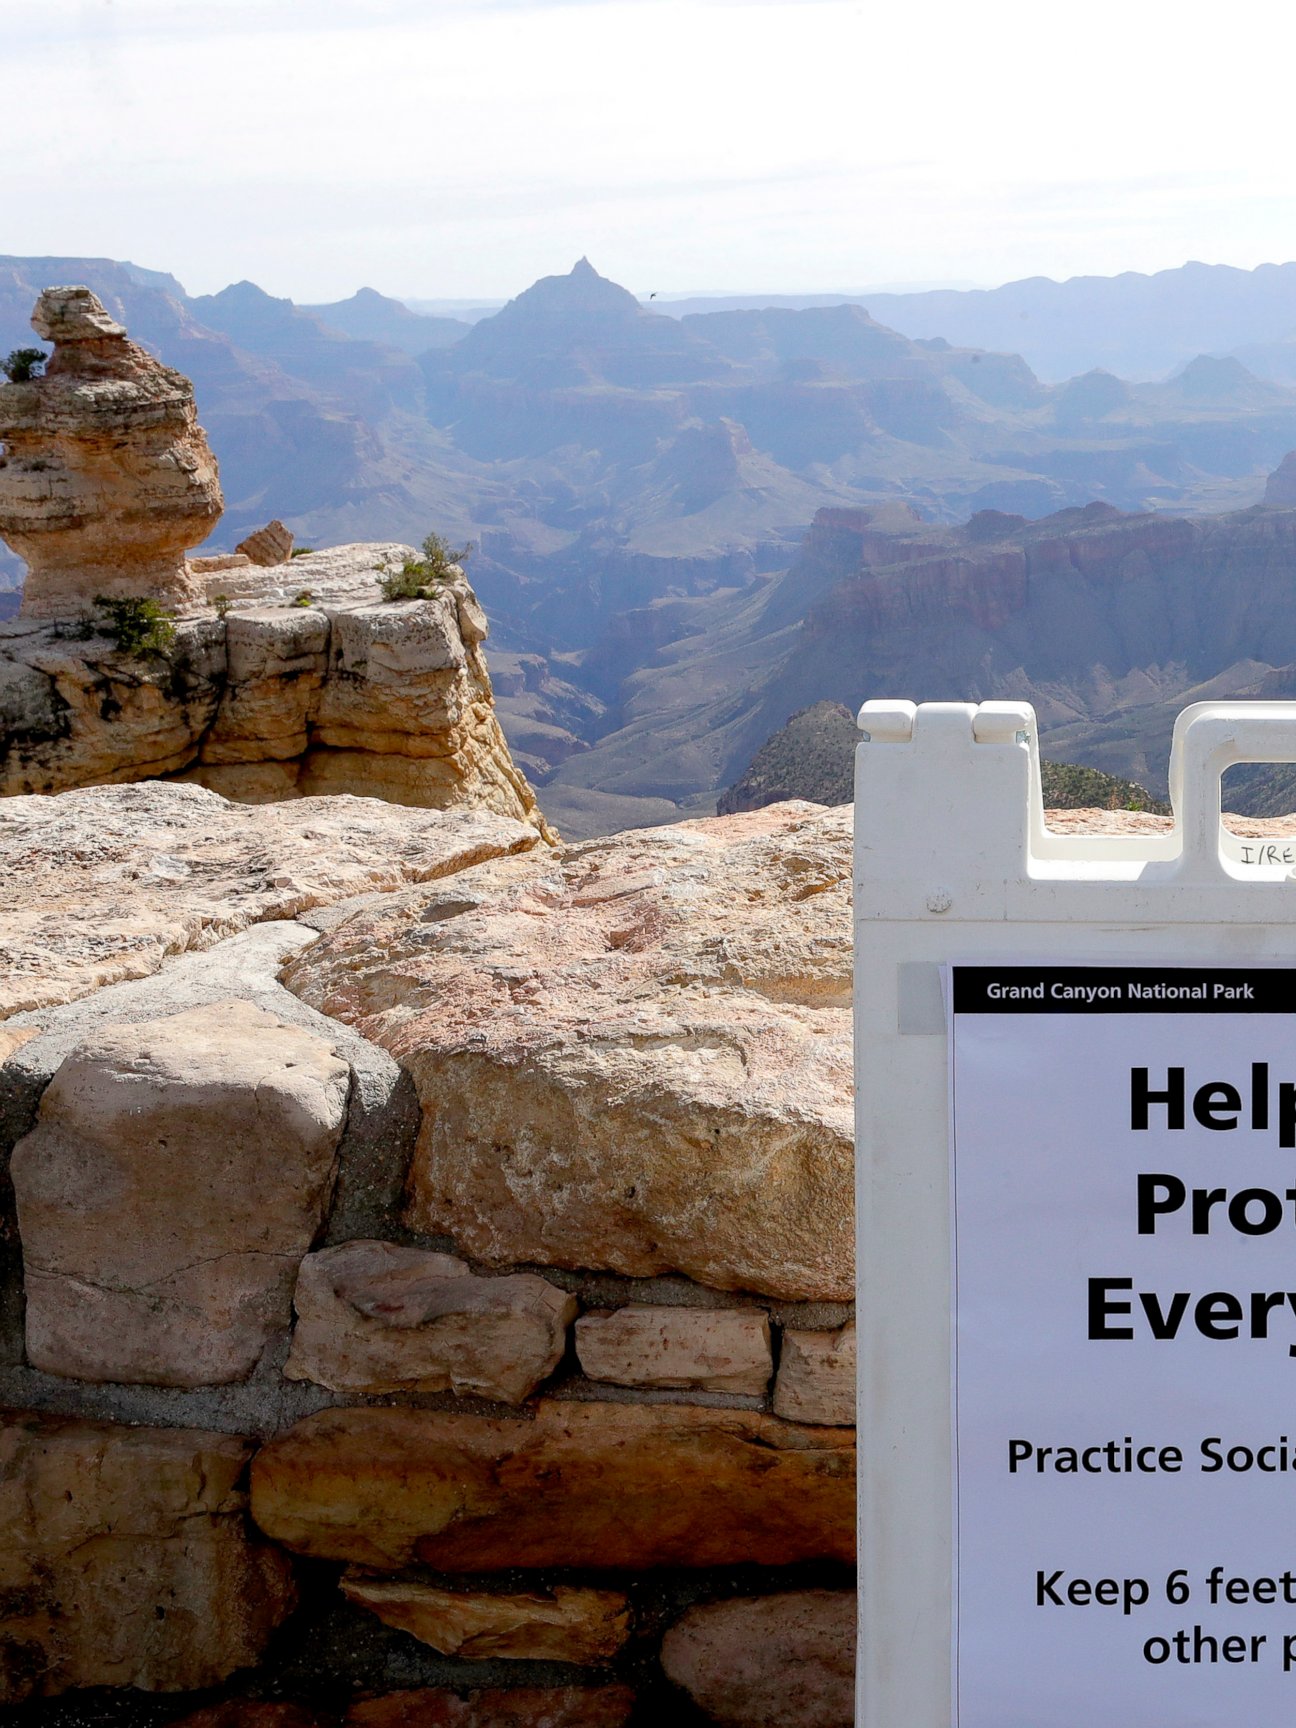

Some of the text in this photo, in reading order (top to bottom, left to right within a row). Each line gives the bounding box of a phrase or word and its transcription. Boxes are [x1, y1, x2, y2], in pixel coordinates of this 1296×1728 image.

[987, 982, 1254, 1002] Grand Canyon National Park
[1008, 1437, 1183, 1473] Practice
[1036, 1571, 1150, 1615] Keep
[1165, 1570, 1190, 1604] 6
[1142, 1625, 1267, 1664] other
